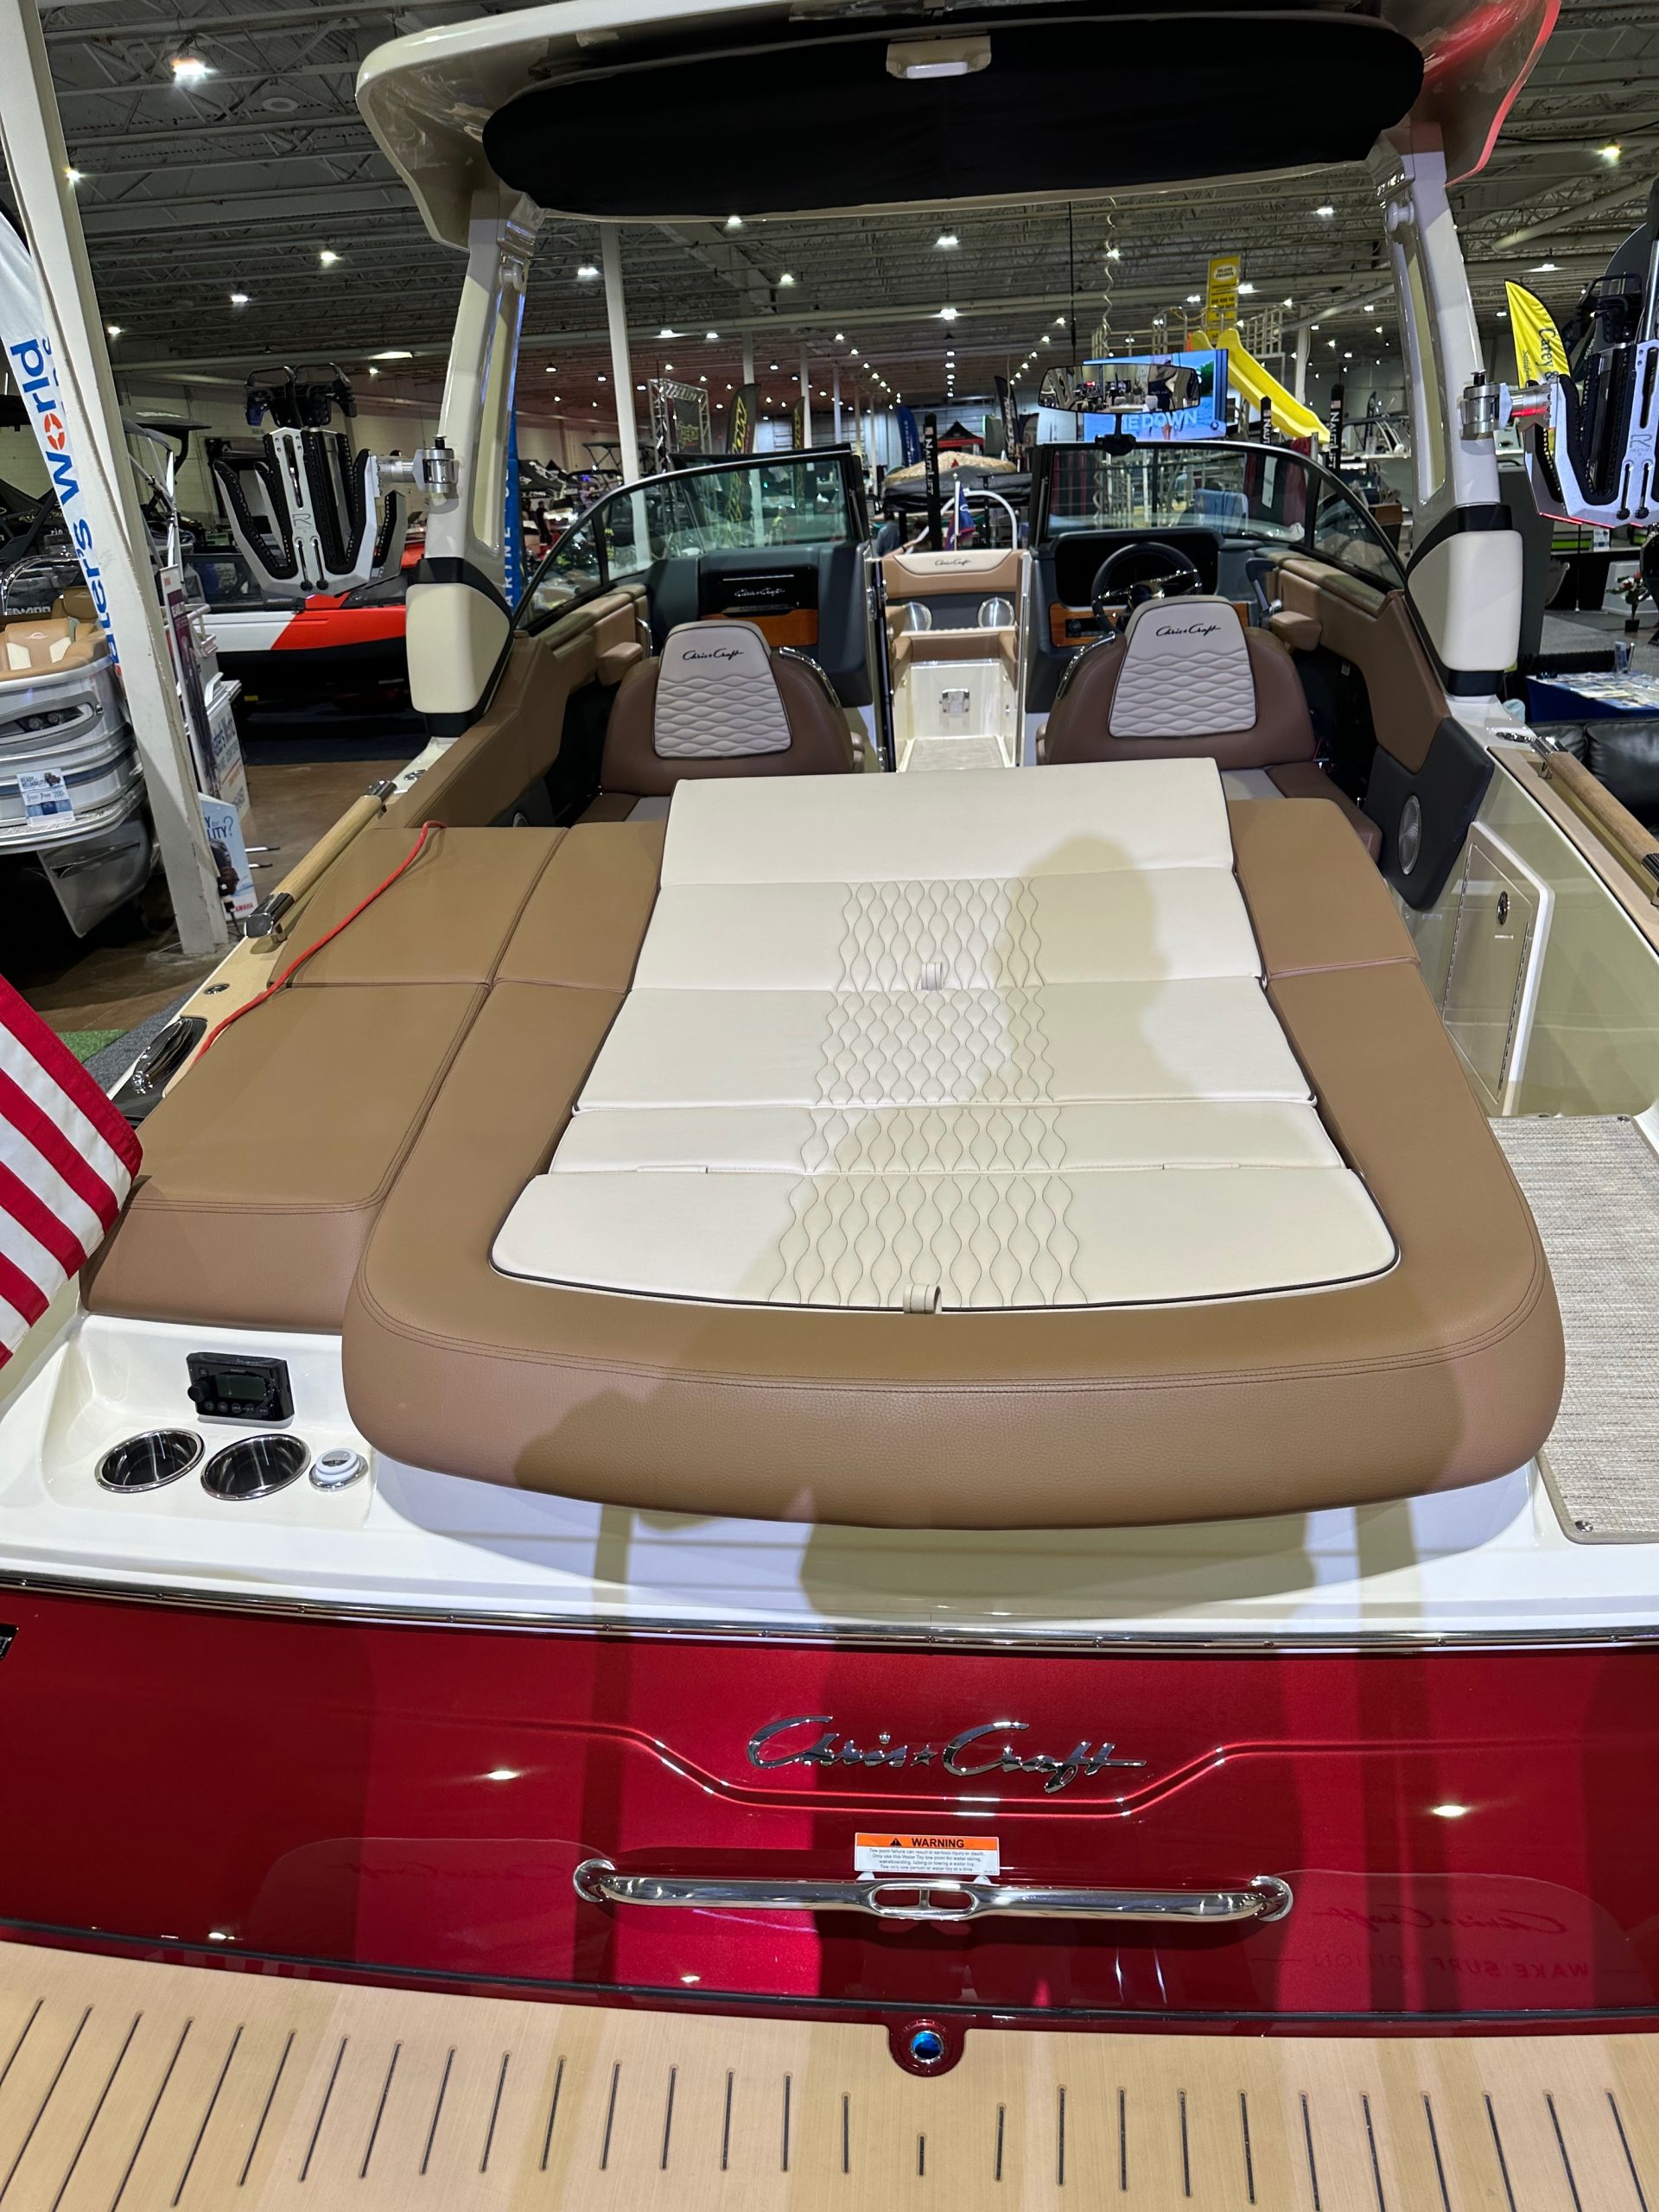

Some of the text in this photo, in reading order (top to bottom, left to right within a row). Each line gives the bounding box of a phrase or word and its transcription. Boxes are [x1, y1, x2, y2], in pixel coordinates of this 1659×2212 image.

[1535, 327, 1556, 367] Carey
[1142, 410, 1198, 428] DOWN
[925, 438, 935, 495] NAUTILIFT
[10, 339, 120, 664] ater's World
[1155, 622, 1221, 637] Chris Craft
[683, 648, 744, 661] Chris Craft
[747, 1714, 1147, 1794] Chris Craft
[912, 1838, 964, 1848] WARNING
